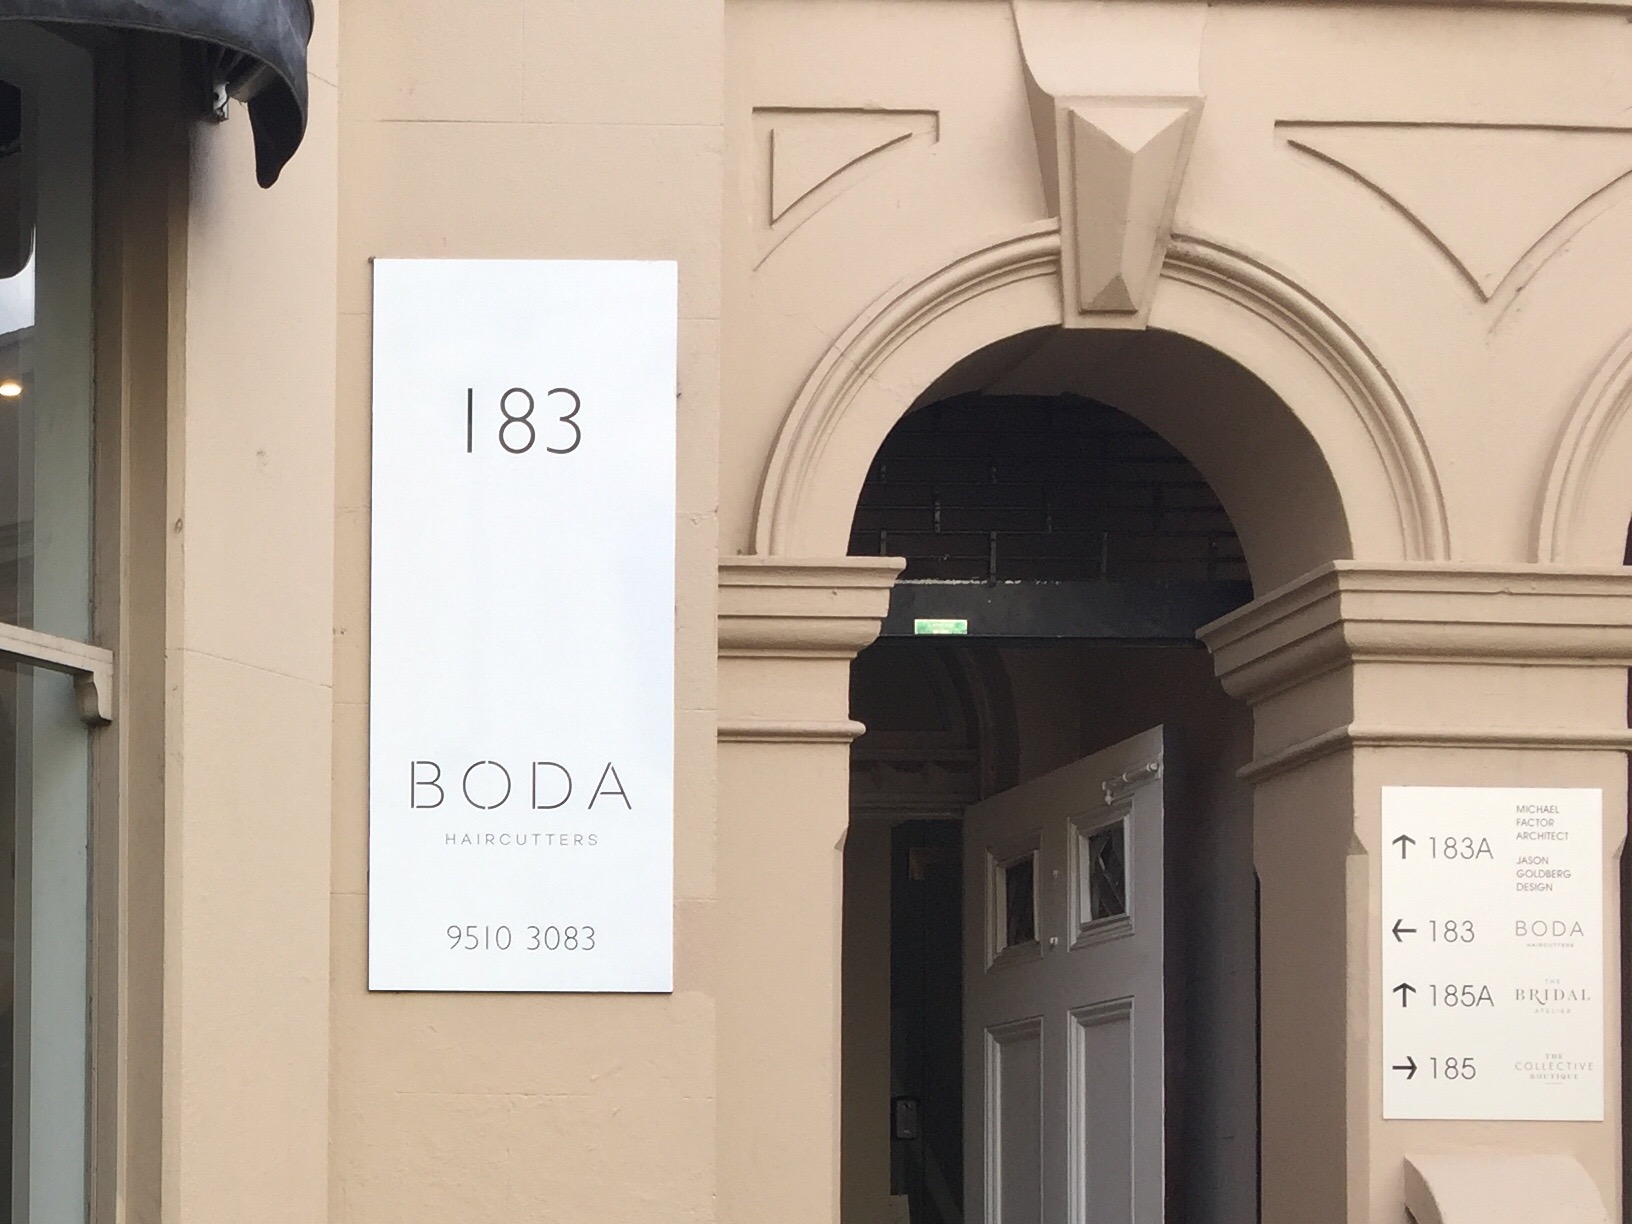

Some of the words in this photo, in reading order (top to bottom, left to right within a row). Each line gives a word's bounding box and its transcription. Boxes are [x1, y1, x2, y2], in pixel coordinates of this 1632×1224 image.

[466, 387, 582, 454] 183
[410, 760, 632, 810] BODA
[1515, 804, 1560, 814] MICHAEL
[1515, 818, 1555, 827] FACTOR
[445, 833, 599, 846] HAIRCUTTERS
[1515, 831, 1569, 841] ARCHITECT
[1429, 836, 1494, 860] 183A
[1516, 856, 1549, 865] JASON
[1516, 869, 1572, 878] GOLDBERG
[1516, 882, 1553, 891] DESIGN
[1429, 919, 1475, 943] 183
[1515, 920, 1584, 937] BODA
[446, 926, 512, 951] 9510
[526, 925, 596, 951] 3083
[1429, 984, 1495, 1007] 185A
[1515, 988, 1591, 1005] BRIDAL
[1429, 1056, 1476, 1080] 185
[1514, 1061, 1594, 1071] COLLECTIVE
